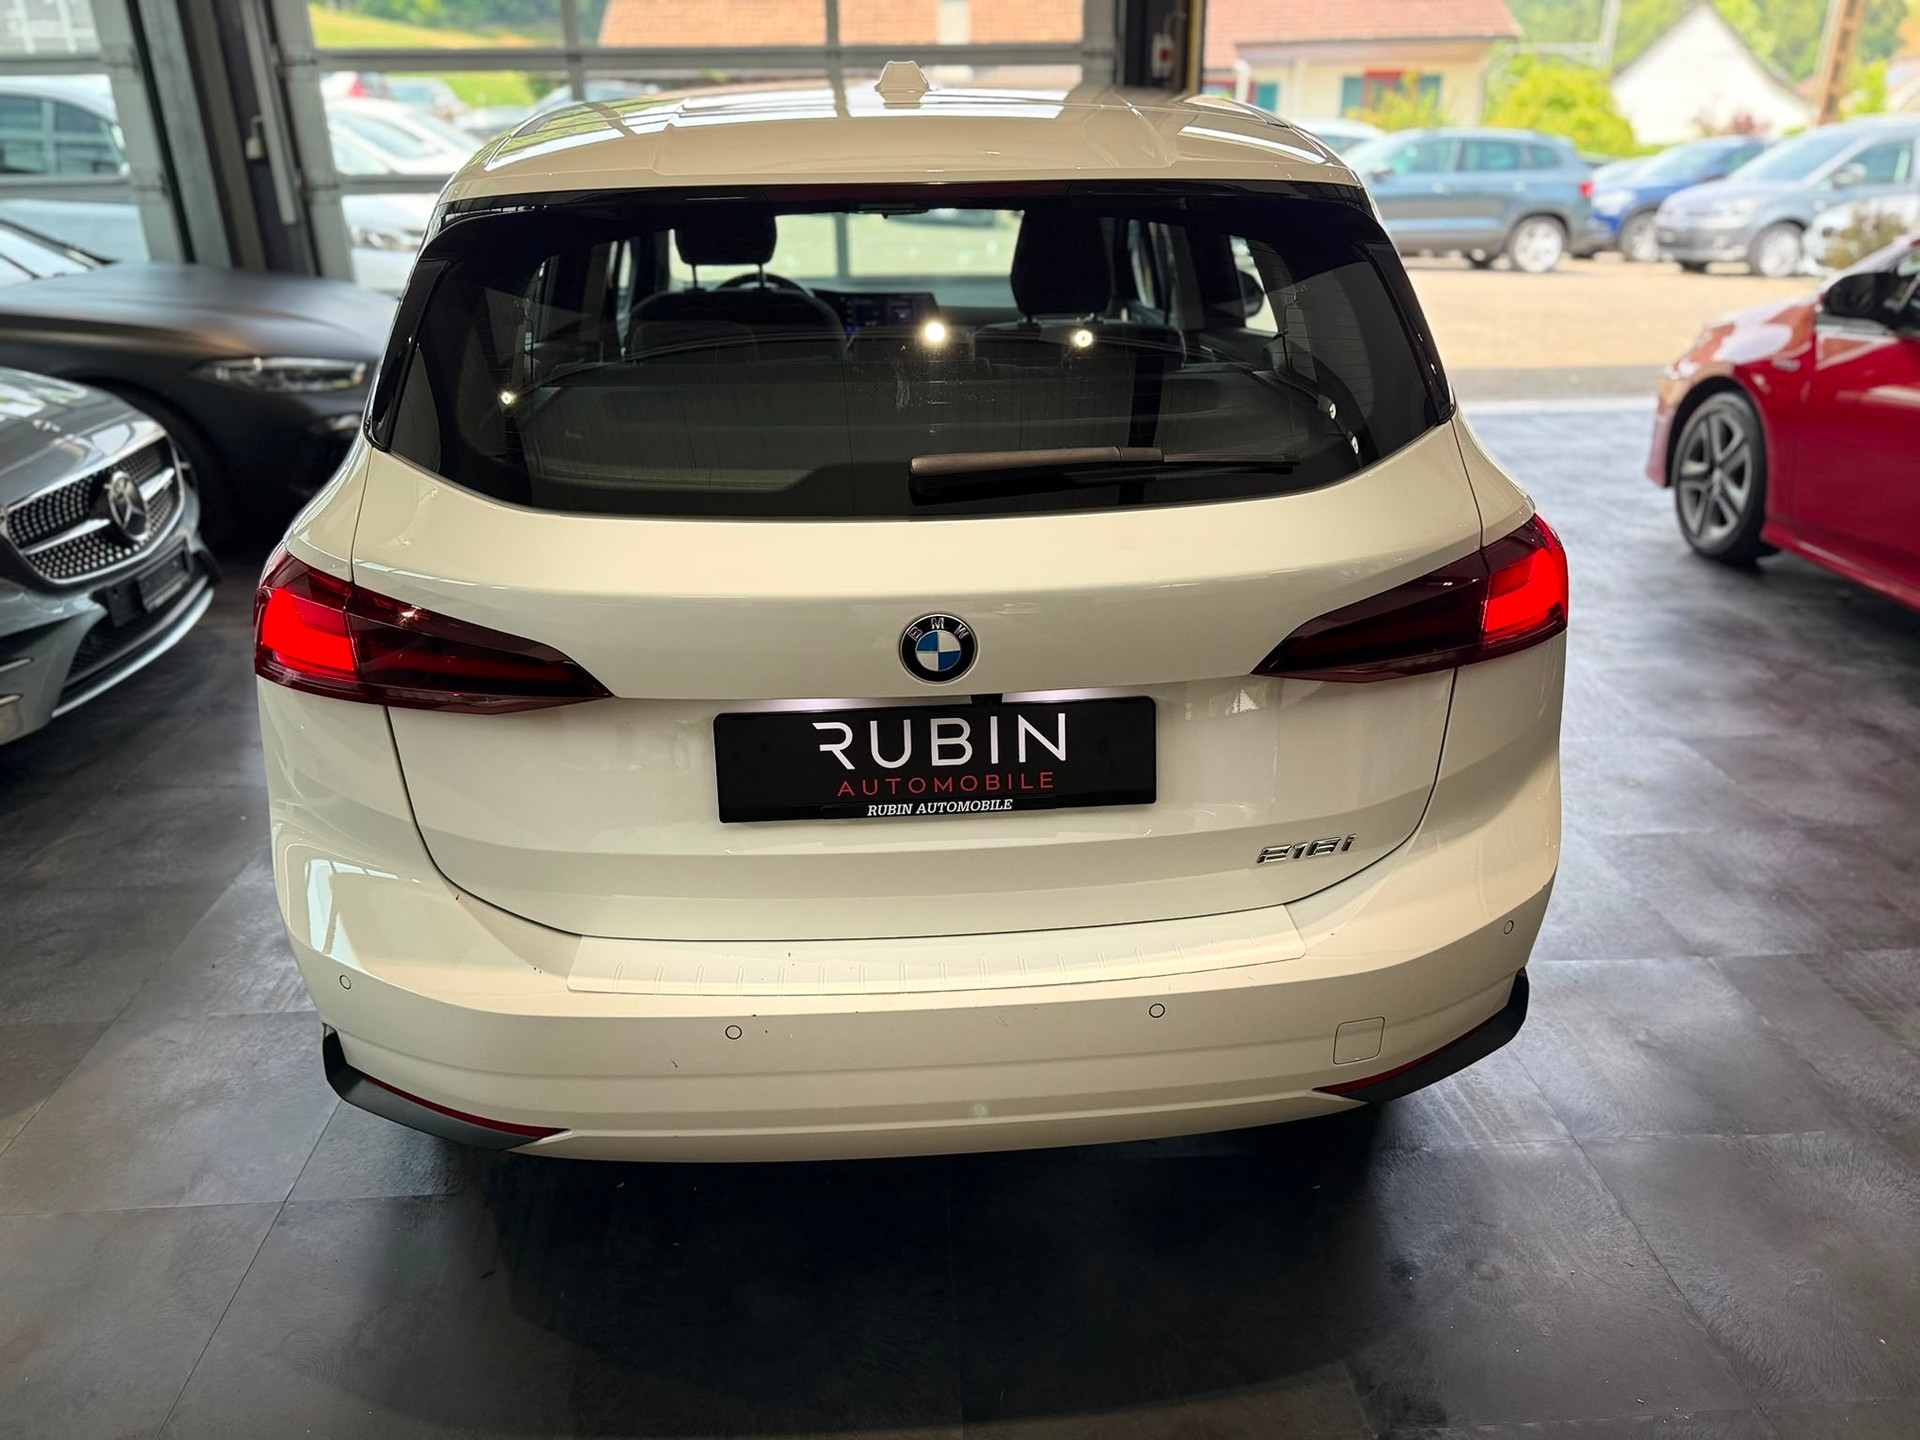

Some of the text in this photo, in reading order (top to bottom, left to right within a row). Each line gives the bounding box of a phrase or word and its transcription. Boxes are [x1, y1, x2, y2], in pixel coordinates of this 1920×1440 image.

[907, 617, 970, 641] BMW
[812, 713, 1066, 770] RUBIN
[837, 772, 1054, 797] AUTOMOBILE
[867, 799, 1014, 816] RUBIN AUTOMOBILE
